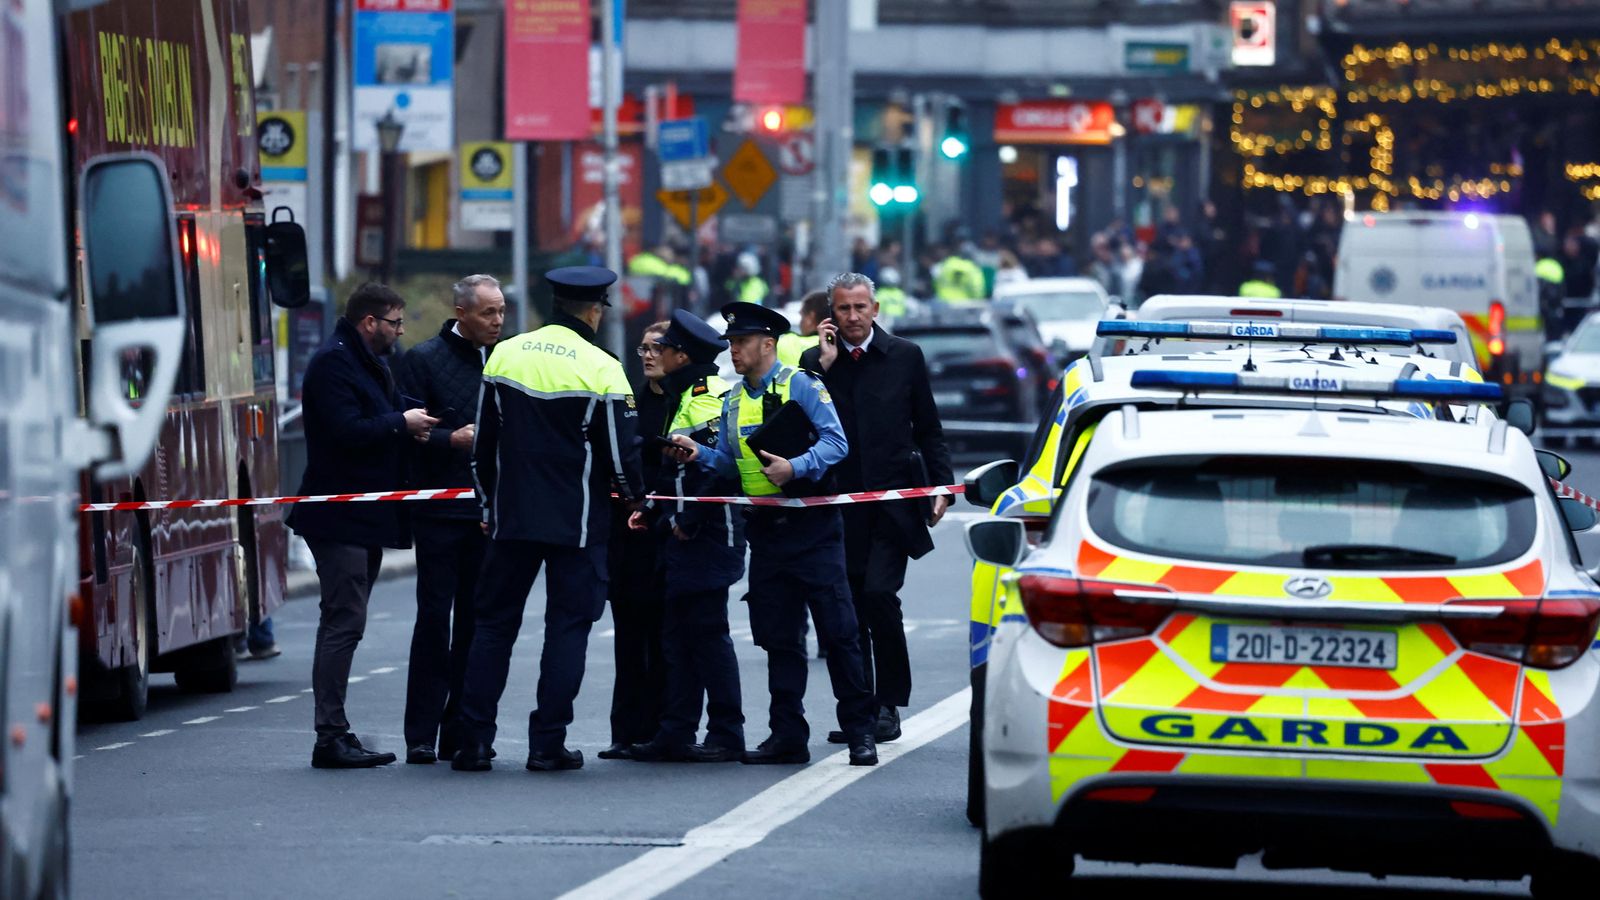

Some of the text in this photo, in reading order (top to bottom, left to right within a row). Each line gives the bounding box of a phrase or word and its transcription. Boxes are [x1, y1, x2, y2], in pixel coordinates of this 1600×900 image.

[146, 38, 195, 148] DUBLIN
[1421, 274, 1486, 290] GARDA
[1235, 326, 1275, 336] GARDA
[522, 341, 577, 360] GARDA
[1293, 377, 1338, 390] GARDA
[1235, 633, 1387, 665] 201-D-22324
[1140, 714, 1469, 751] GARDA
